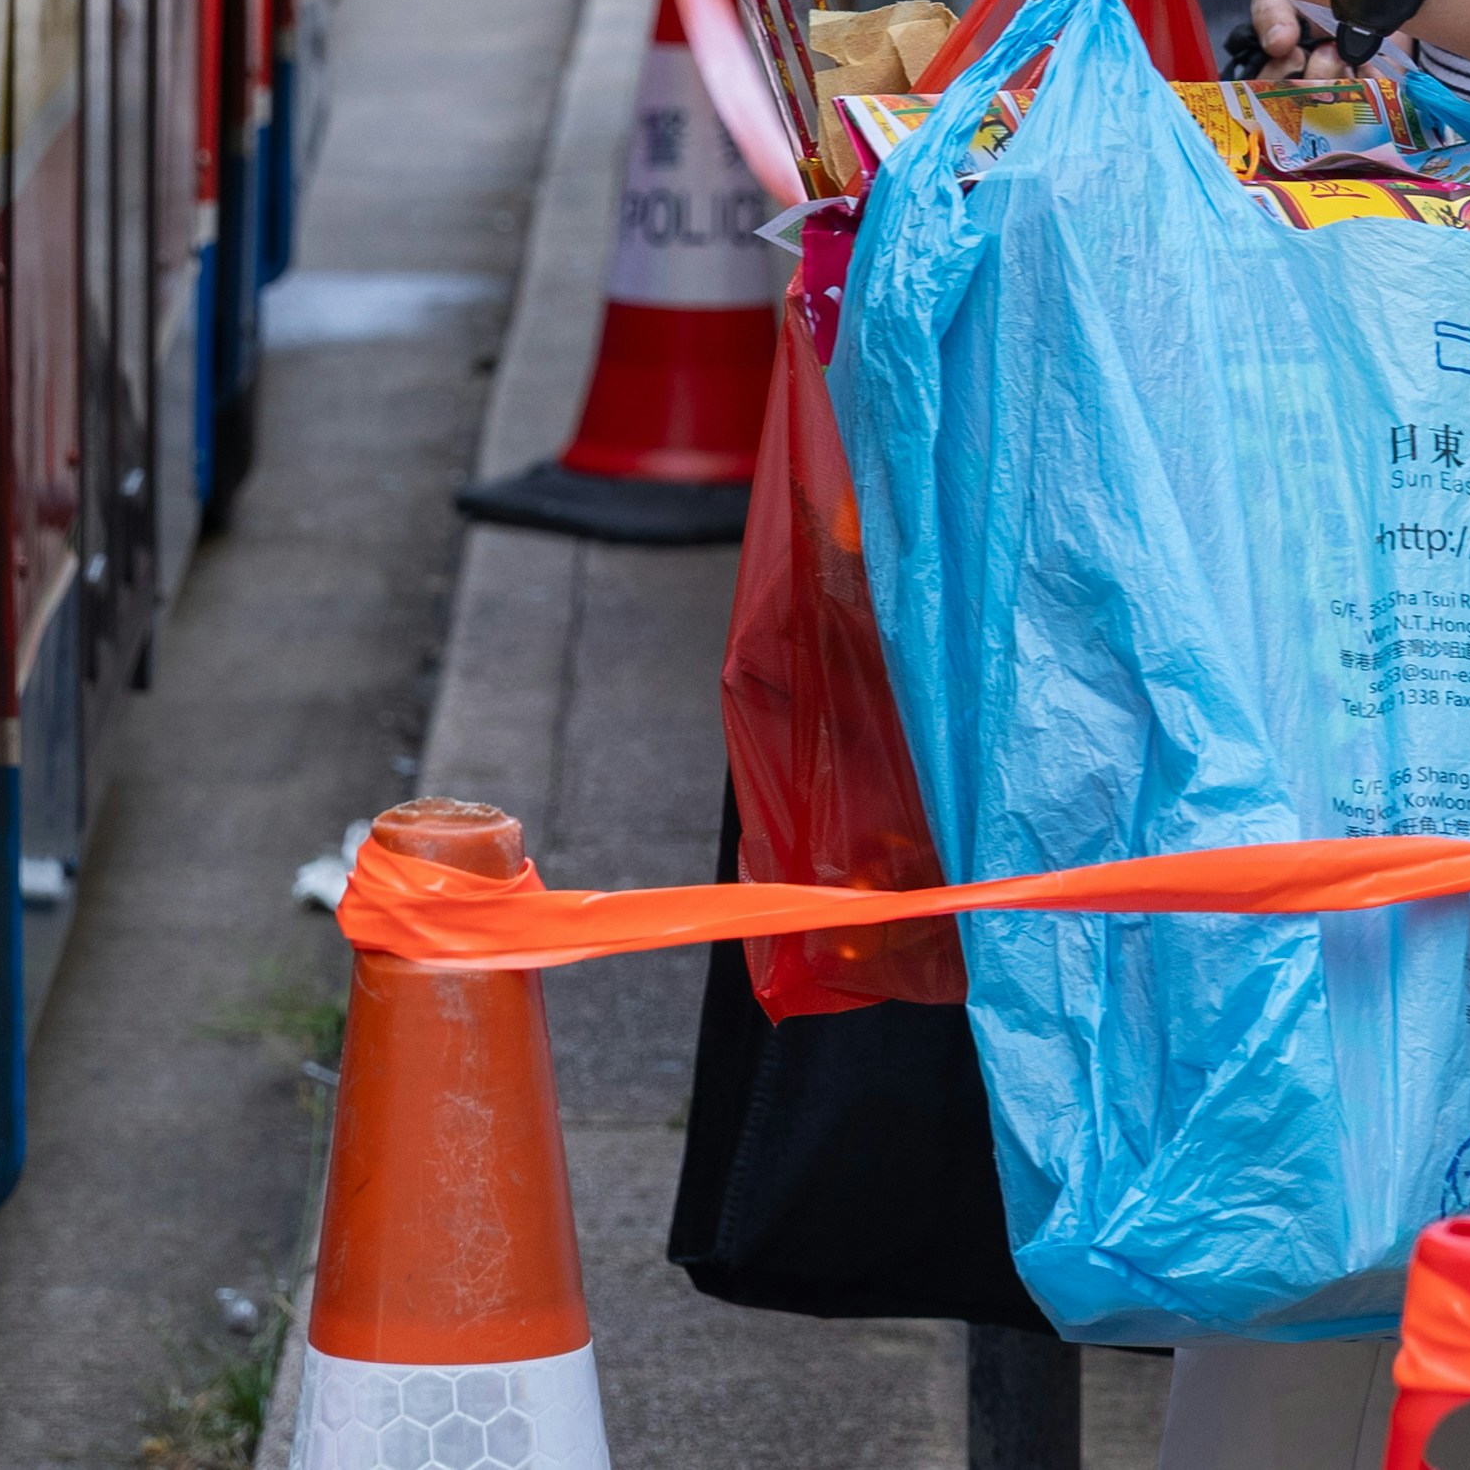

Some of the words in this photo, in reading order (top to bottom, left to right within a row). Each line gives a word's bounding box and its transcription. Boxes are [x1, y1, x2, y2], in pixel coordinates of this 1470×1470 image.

[1390, 469, 1432, 490] Sun
[1422, 591, 1456, 608] Tsui
[1398, 689, 1440, 706] 1338
